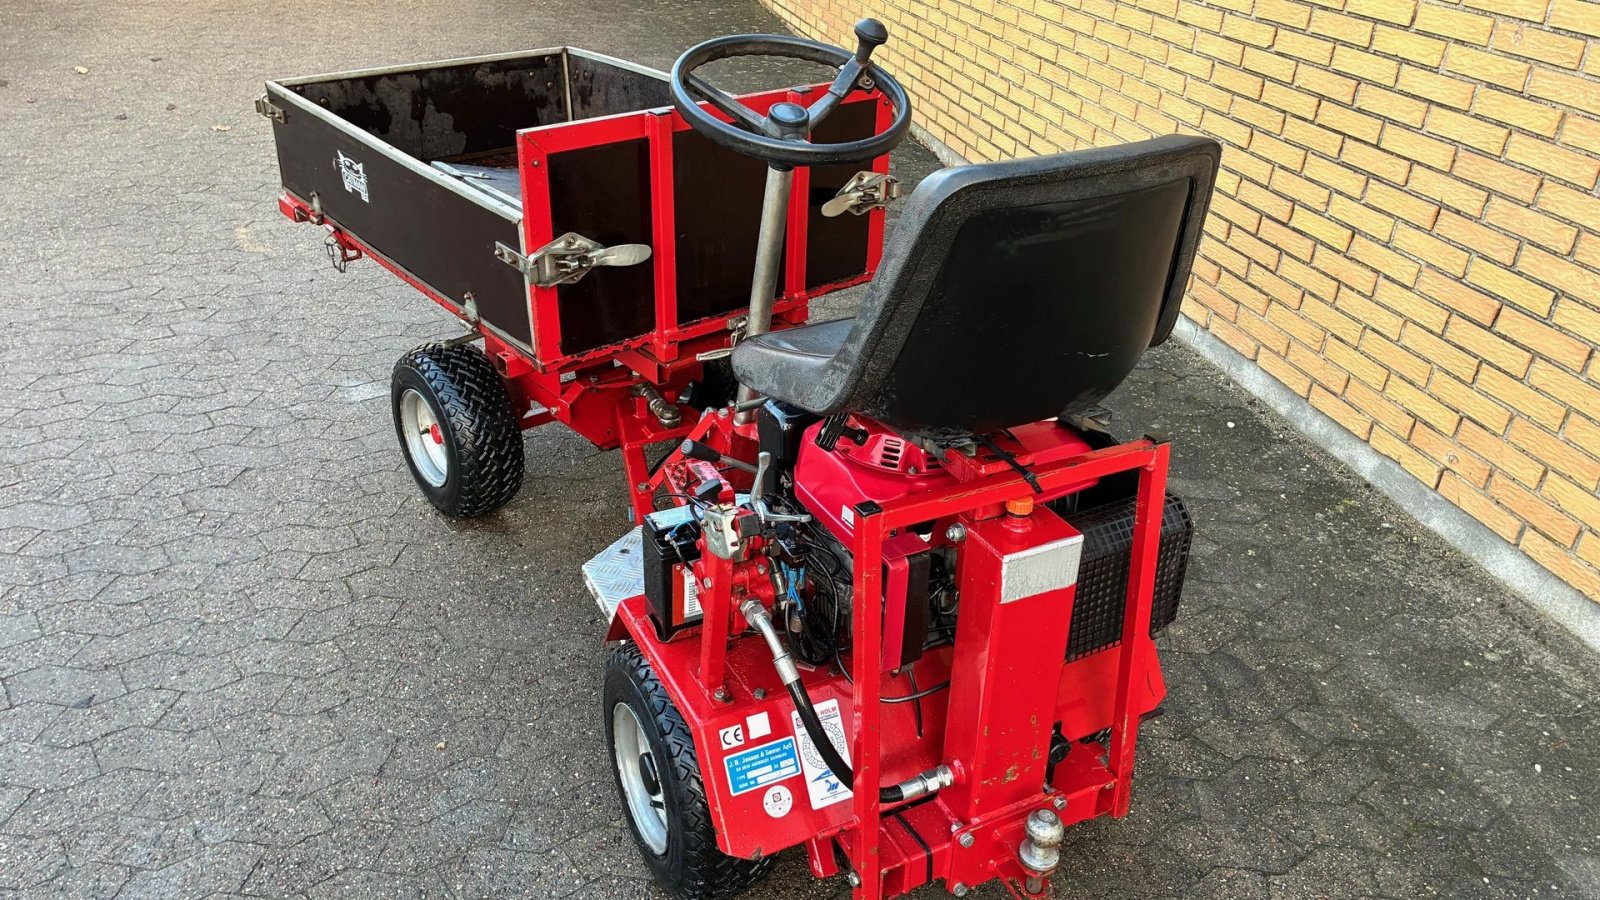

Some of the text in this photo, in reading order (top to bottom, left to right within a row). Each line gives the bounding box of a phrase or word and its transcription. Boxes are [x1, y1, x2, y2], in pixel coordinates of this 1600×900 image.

[820, 706, 837, 715] HOLM
[722, 727, 743, 745] CE
[742, 754, 760, 763] Jensen
[782, 742, 793, 751] ApS
